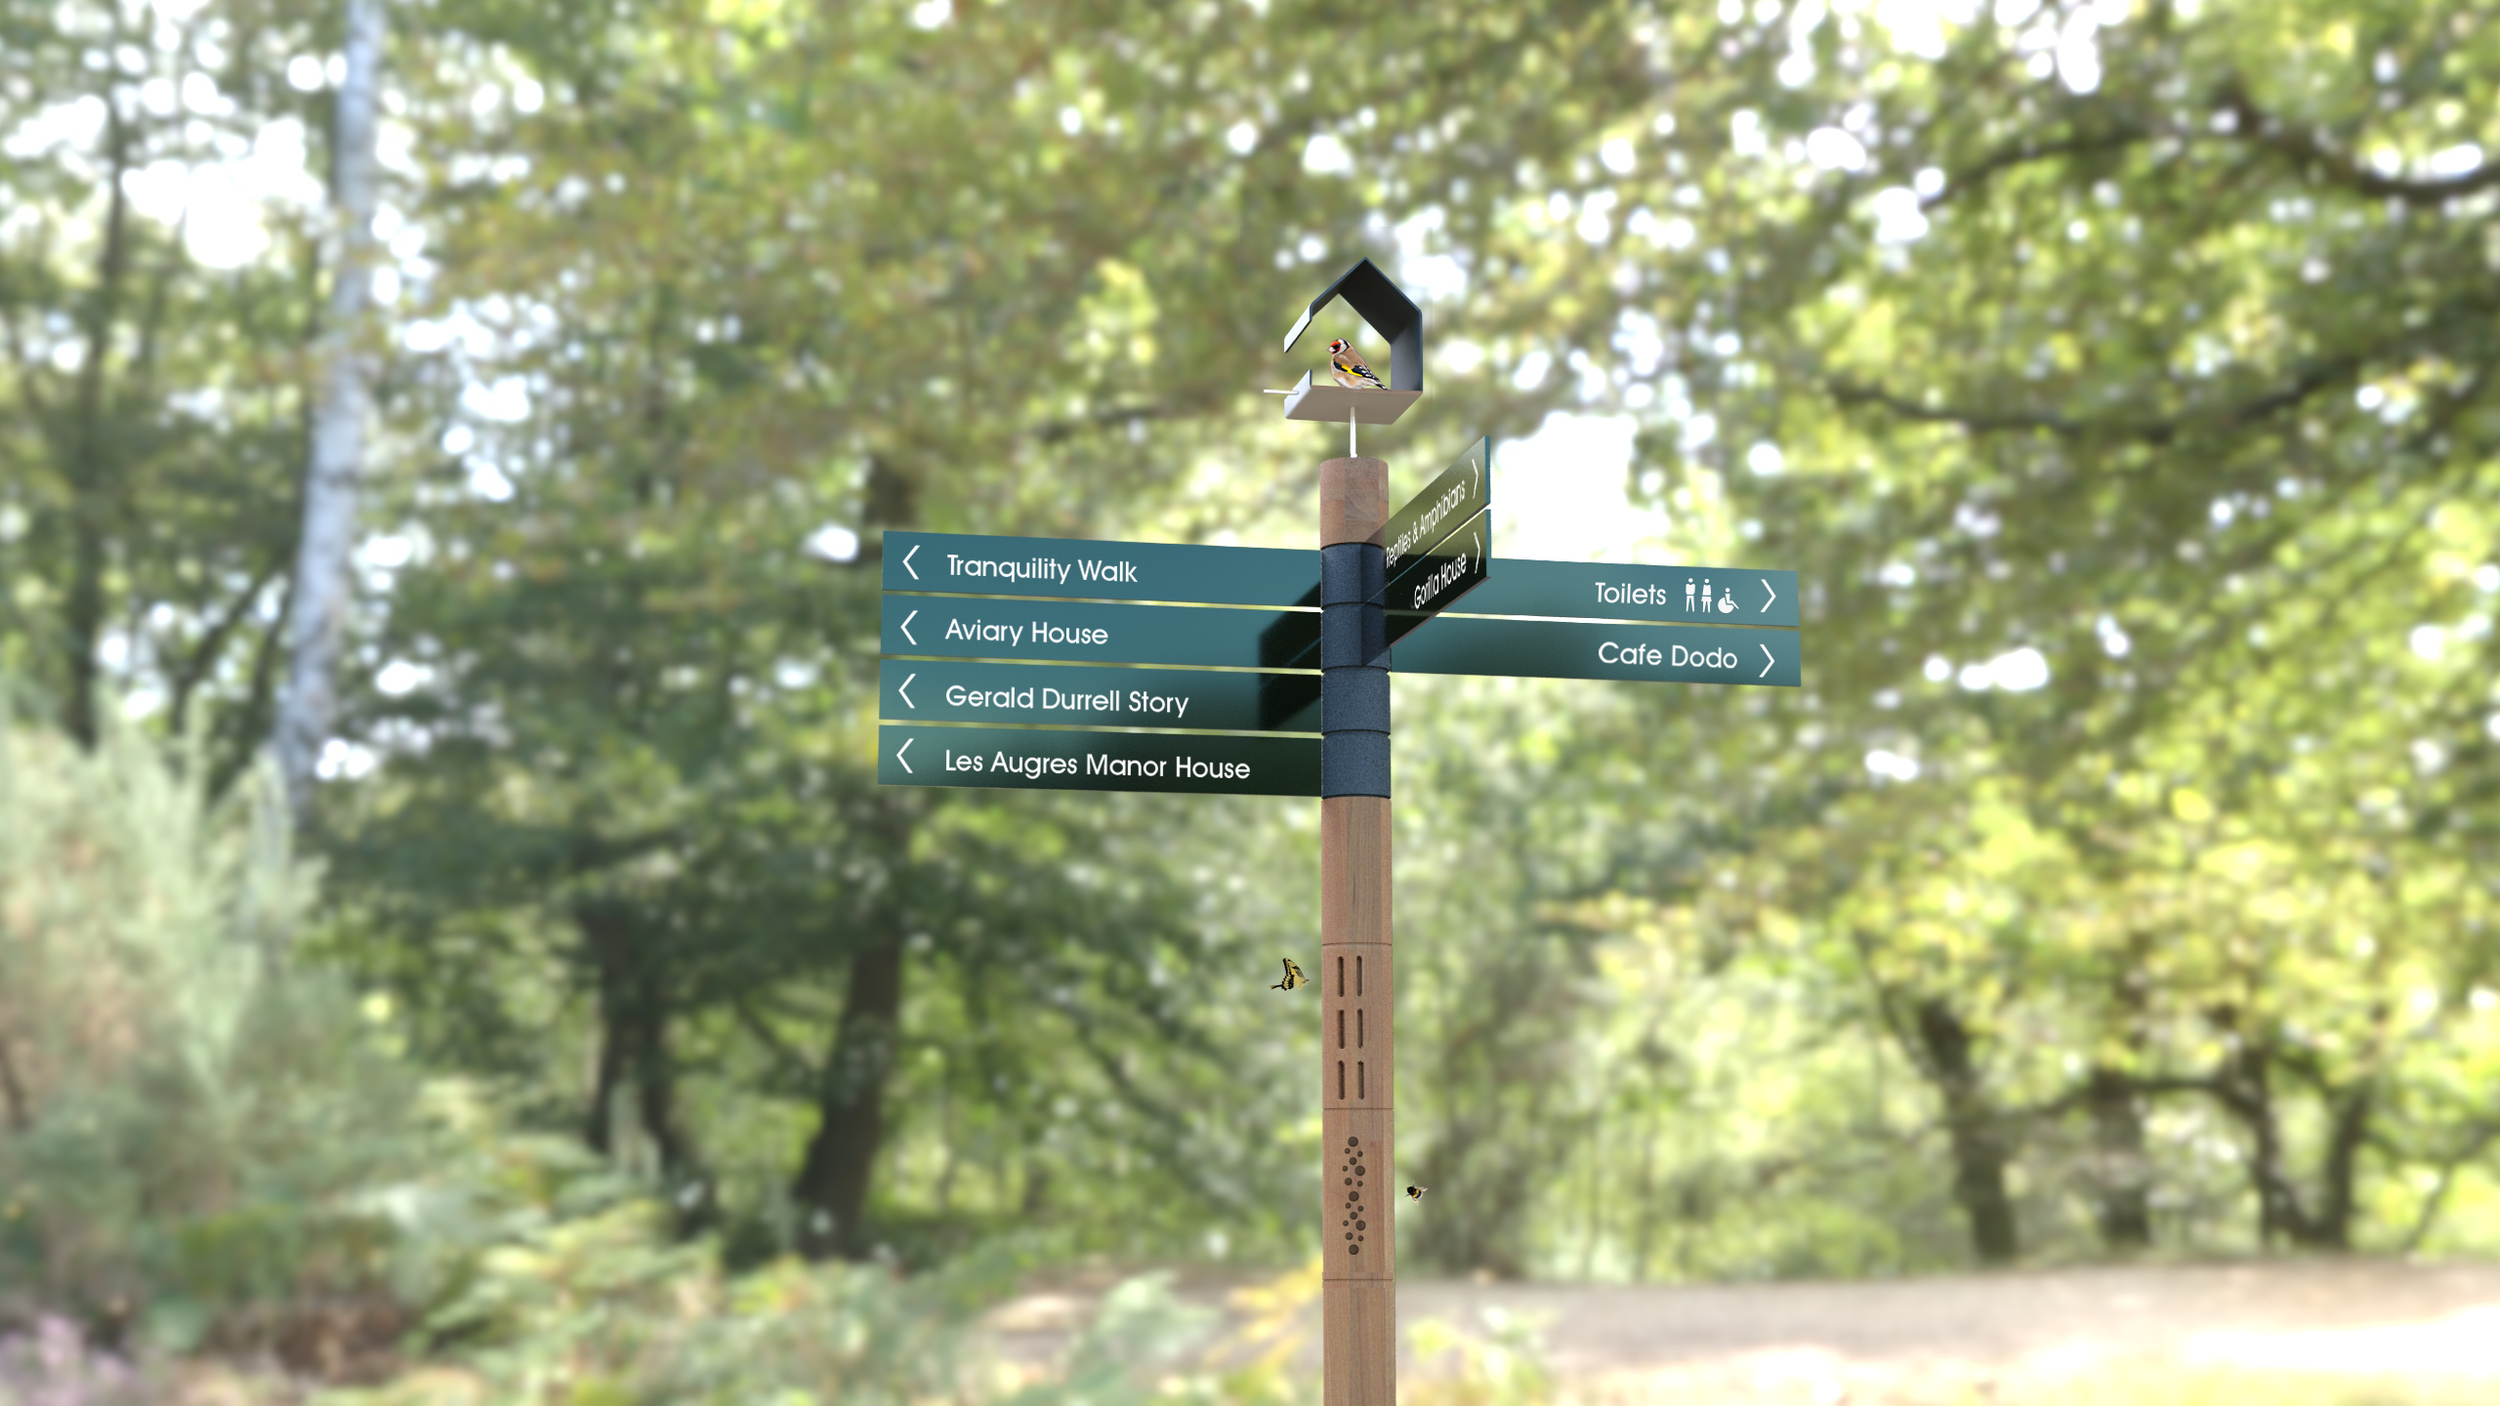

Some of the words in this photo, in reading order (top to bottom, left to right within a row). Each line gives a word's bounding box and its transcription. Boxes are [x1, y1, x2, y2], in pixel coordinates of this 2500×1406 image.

[1386, 530, 1411, 569] Reptiles
[1412, 521, 1419, 545] &
[1419, 480, 1466, 539] Amphibians
[946, 554, 1072, 585] Tranquility
[1077, 559, 1138, 583] Walk
[1414, 574, 1440, 609] Gorilla
[1440, 552, 1467, 590] House
[1594, 581, 1667, 606] Toilets
[944, 618, 1024, 647] Aviary
[1032, 621, 1109, 645] House
[1598, 641, 1663, 666] Cafe
[1671, 644, 1738, 669] Dodo
[945, 684, 1034, 709] Gerald
[1042, 687, 1120, 712] Durrell
[1128, 690, 1189, 719] Story
[945, 749, 983, 772] Les
[990, 751, 1078, 780] Augres
[1086, 753, 1167, 777] Manor
[1176, 756, 1251, 780] House
